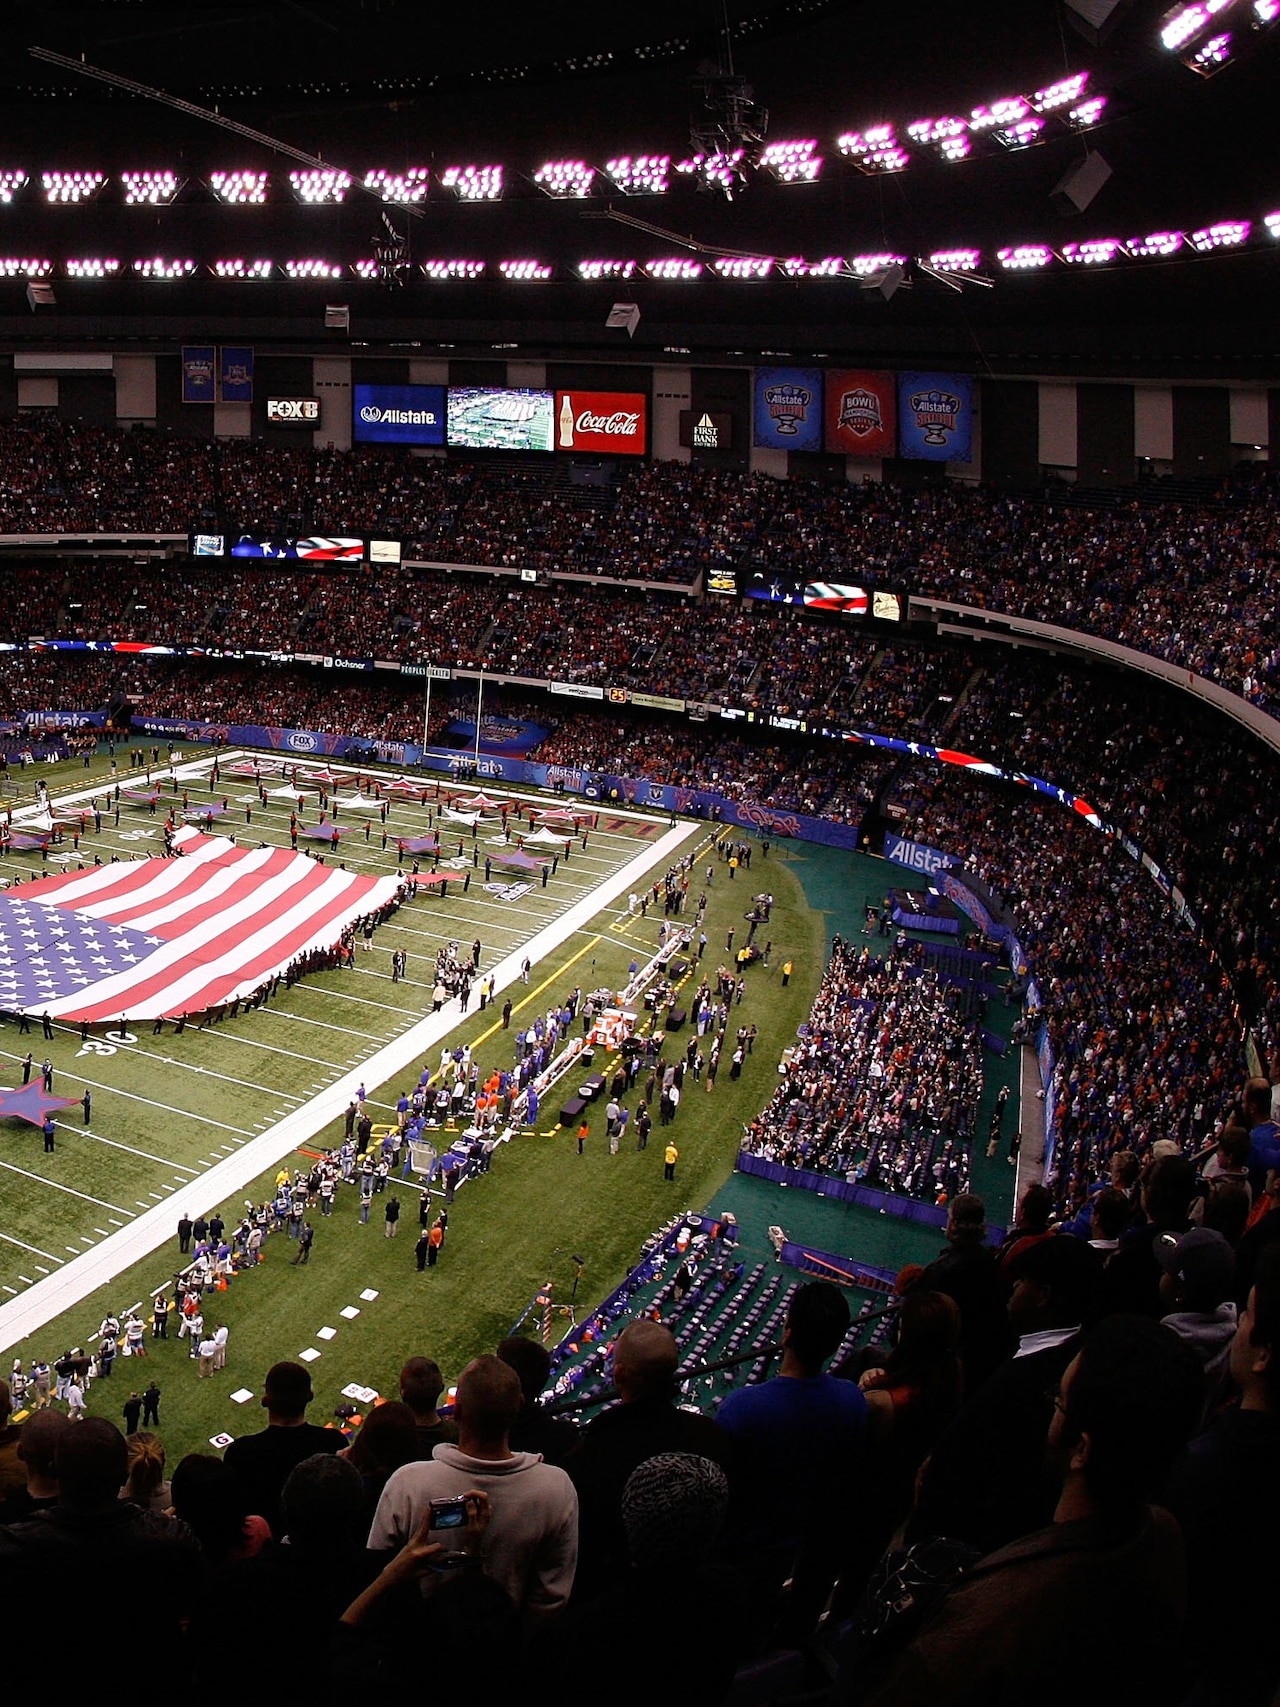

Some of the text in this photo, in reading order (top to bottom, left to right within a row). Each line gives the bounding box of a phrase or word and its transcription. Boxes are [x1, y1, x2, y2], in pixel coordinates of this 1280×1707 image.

[771, 394, 802, 405] Allstate
[846, 396, 874, 409] BOWL
[268, 400, 318, 418] FOX 8
[917, 401, 951, 413] Allstate
[576, 410, 640, 435] Coca-Cola
[694, 426, 718, 435] FIRST
[694, 434, 718, 443] BANK
[334, 659, 366, 670] Ochsner
[611, 690, 625, 701] 25
[293, 735, 311, 745] FOX
[547, 766, 582, 780] Allstate
[889, 840, 953, 872] Allstat
[82, 1030, 138, 1056] 30
